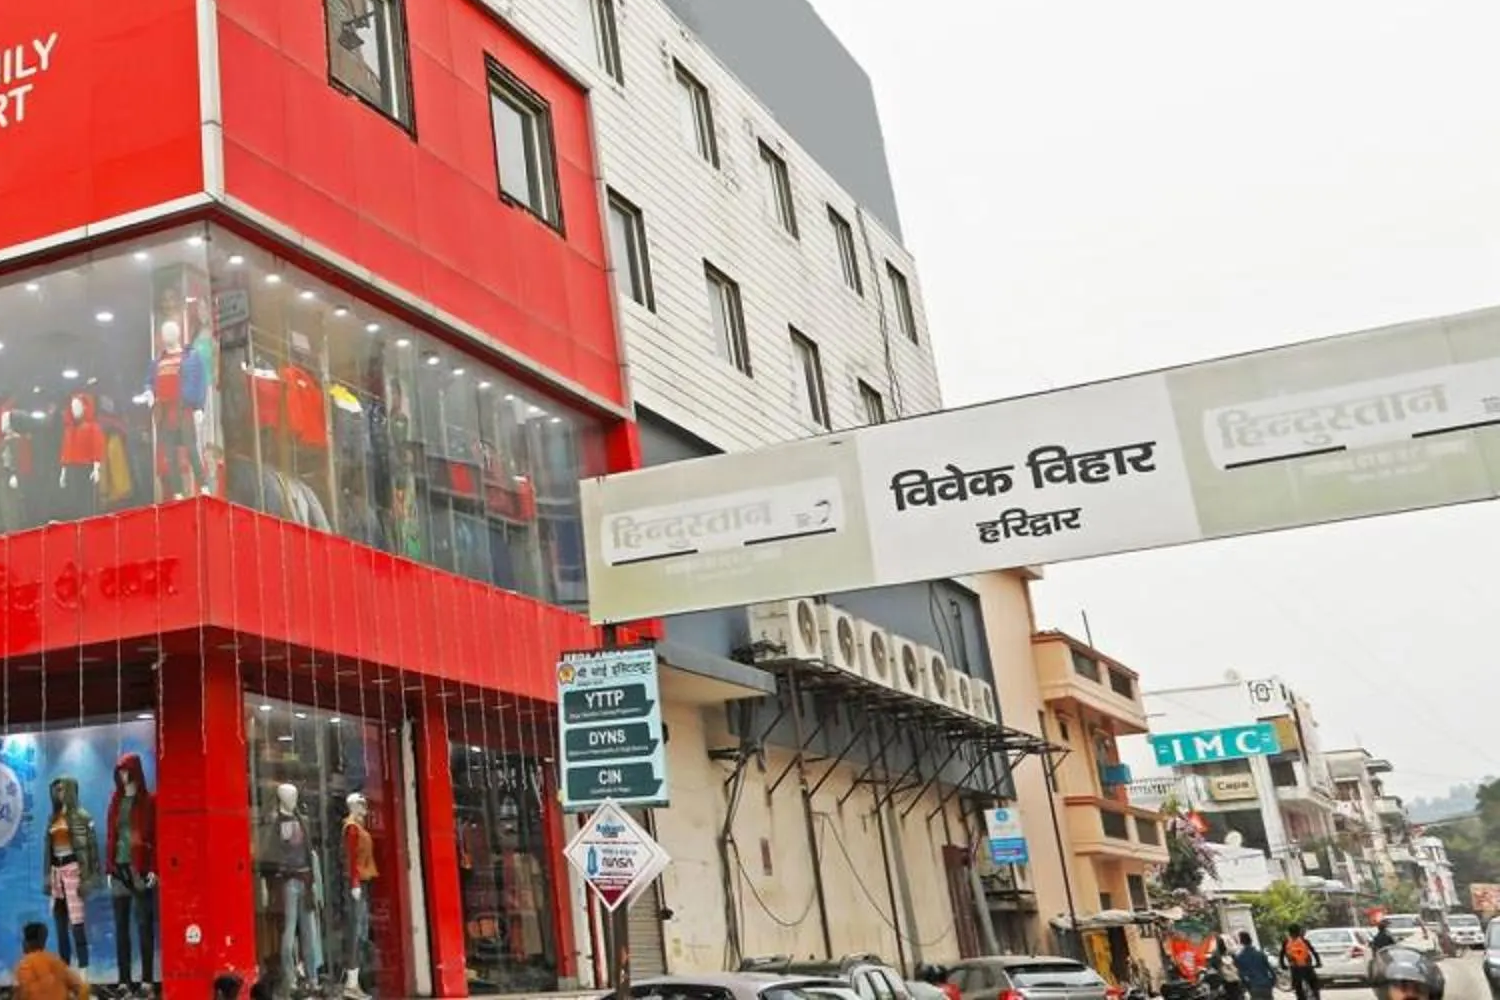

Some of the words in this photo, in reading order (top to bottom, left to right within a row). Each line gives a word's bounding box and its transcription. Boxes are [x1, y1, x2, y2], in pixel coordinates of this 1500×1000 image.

[890, 463, 1015, 512] विवेक
[1026, 441, 1157, 489] विहार
[976, 507, 1083, 543] हरिद्वार
[585, 689, 626, 709] YTTP
[589, 729, 627, 746] DYNS
